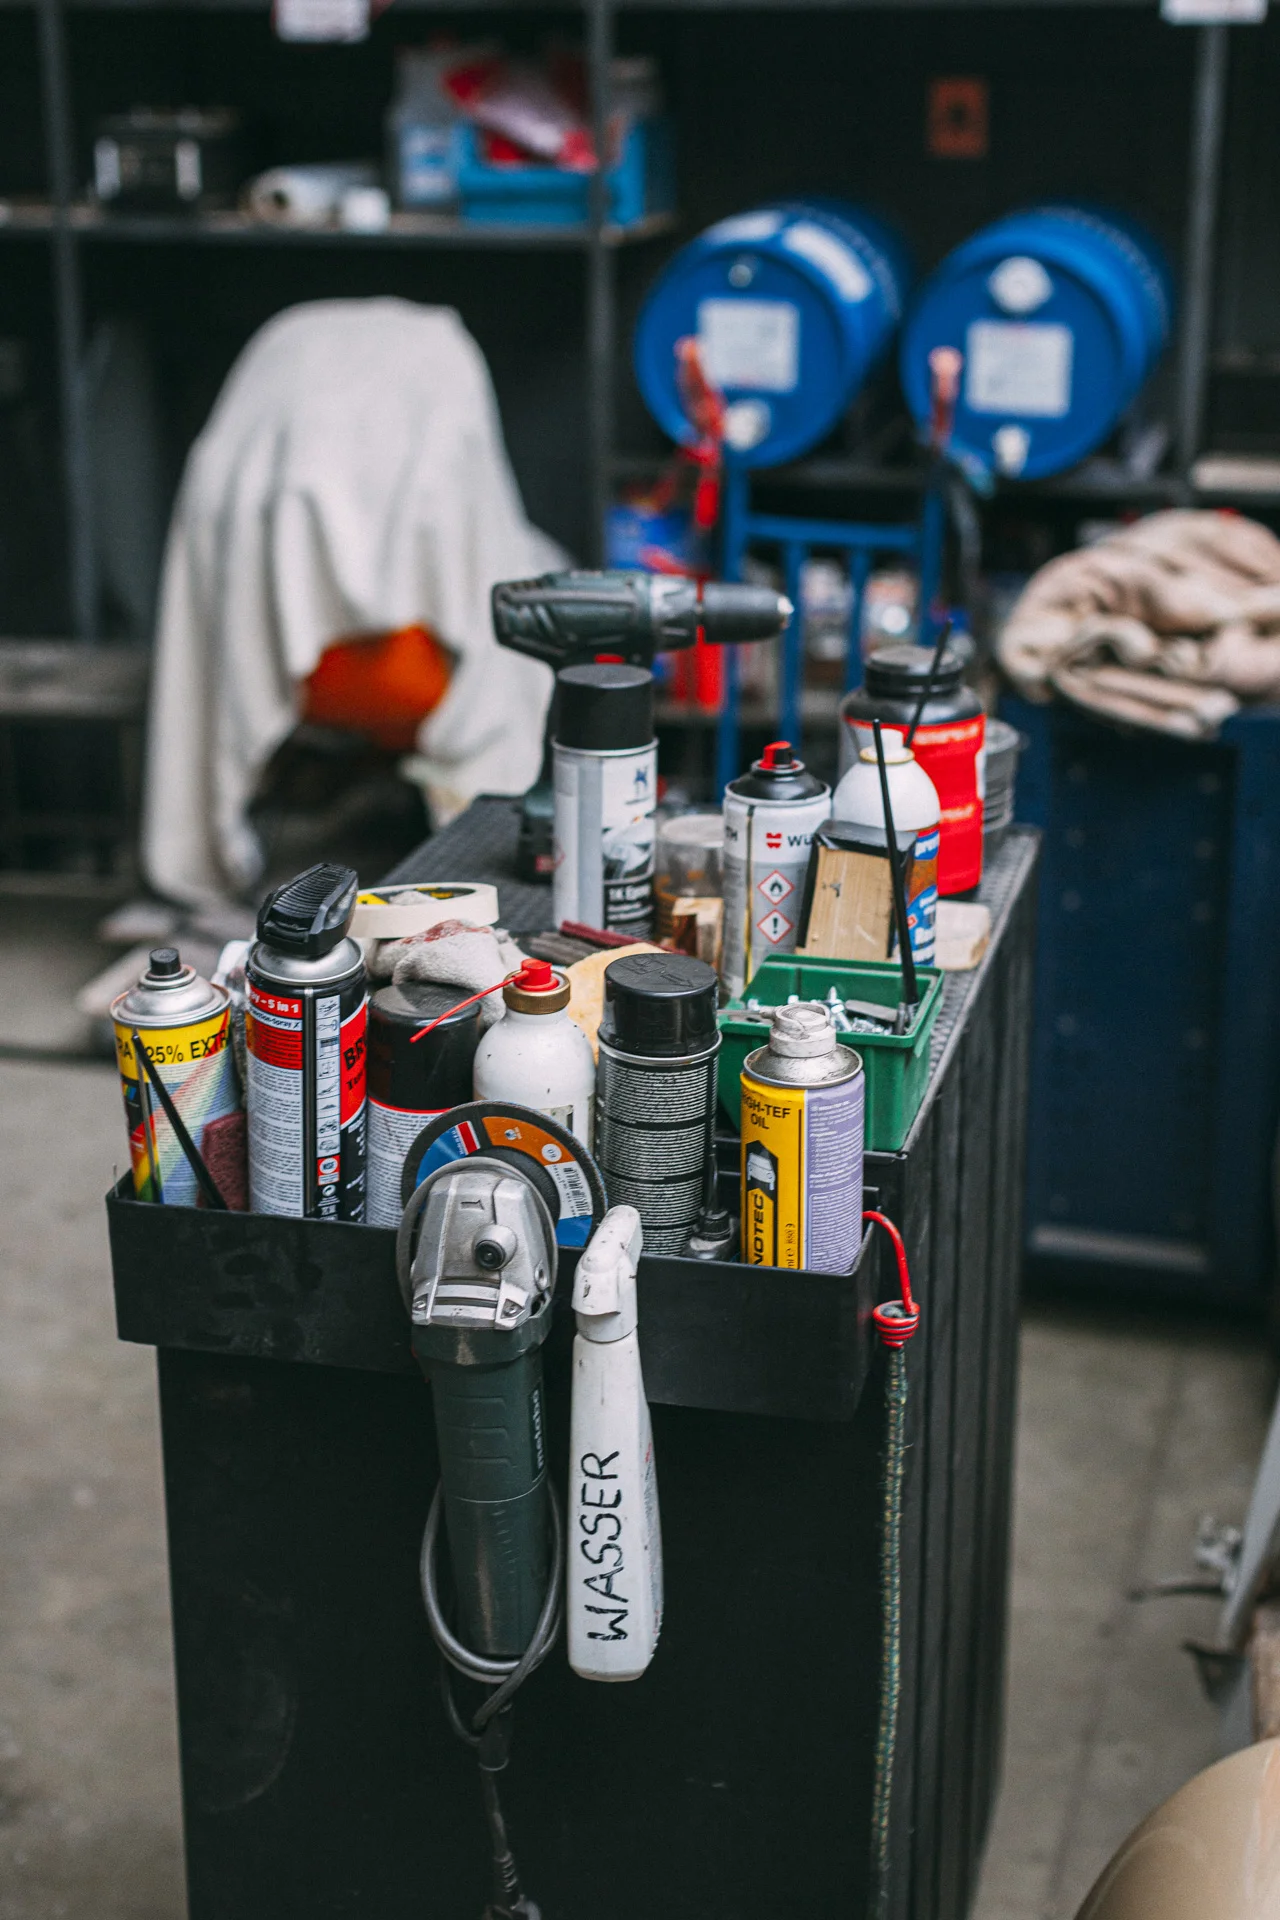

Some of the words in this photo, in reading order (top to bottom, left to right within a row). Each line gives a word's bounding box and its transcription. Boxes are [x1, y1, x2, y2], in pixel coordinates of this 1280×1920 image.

[267, 999, 275, 1009] 5
[276, 1001, 289, 1013] in
[290, 1004, 299, 1014] 1
[144, 1044, 184, 1064] 25%
[751, 1112, 770, 1130] OIL
[580, 1451, 629, 1641] WASSER
